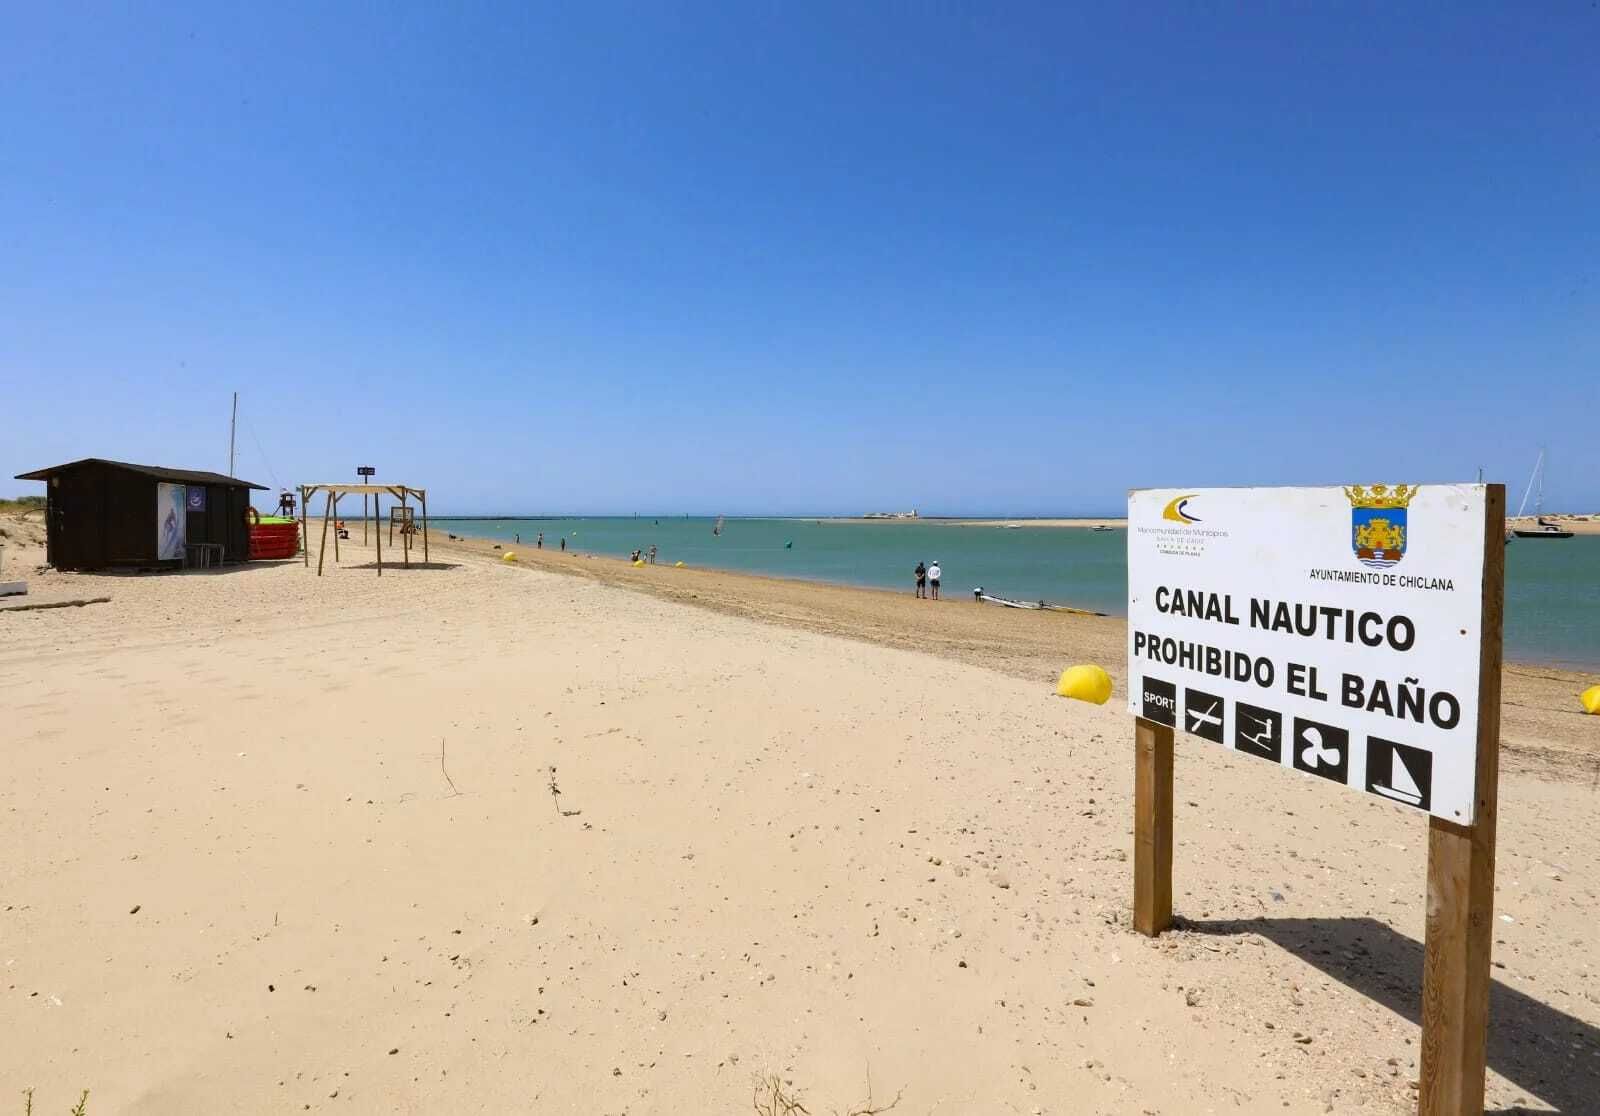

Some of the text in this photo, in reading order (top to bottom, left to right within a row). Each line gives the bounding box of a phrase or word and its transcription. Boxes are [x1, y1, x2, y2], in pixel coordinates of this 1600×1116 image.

[1310, 569, 1454, 591] AYUNTAMIENTO DE CHICLANA
[1155, 586, 1416, 652] CANAL NAUTICO
[1134, 631, 1461, 730] PROHIBIDO EL BAÑO
[1144, 691, 1175, 710] SPORT
